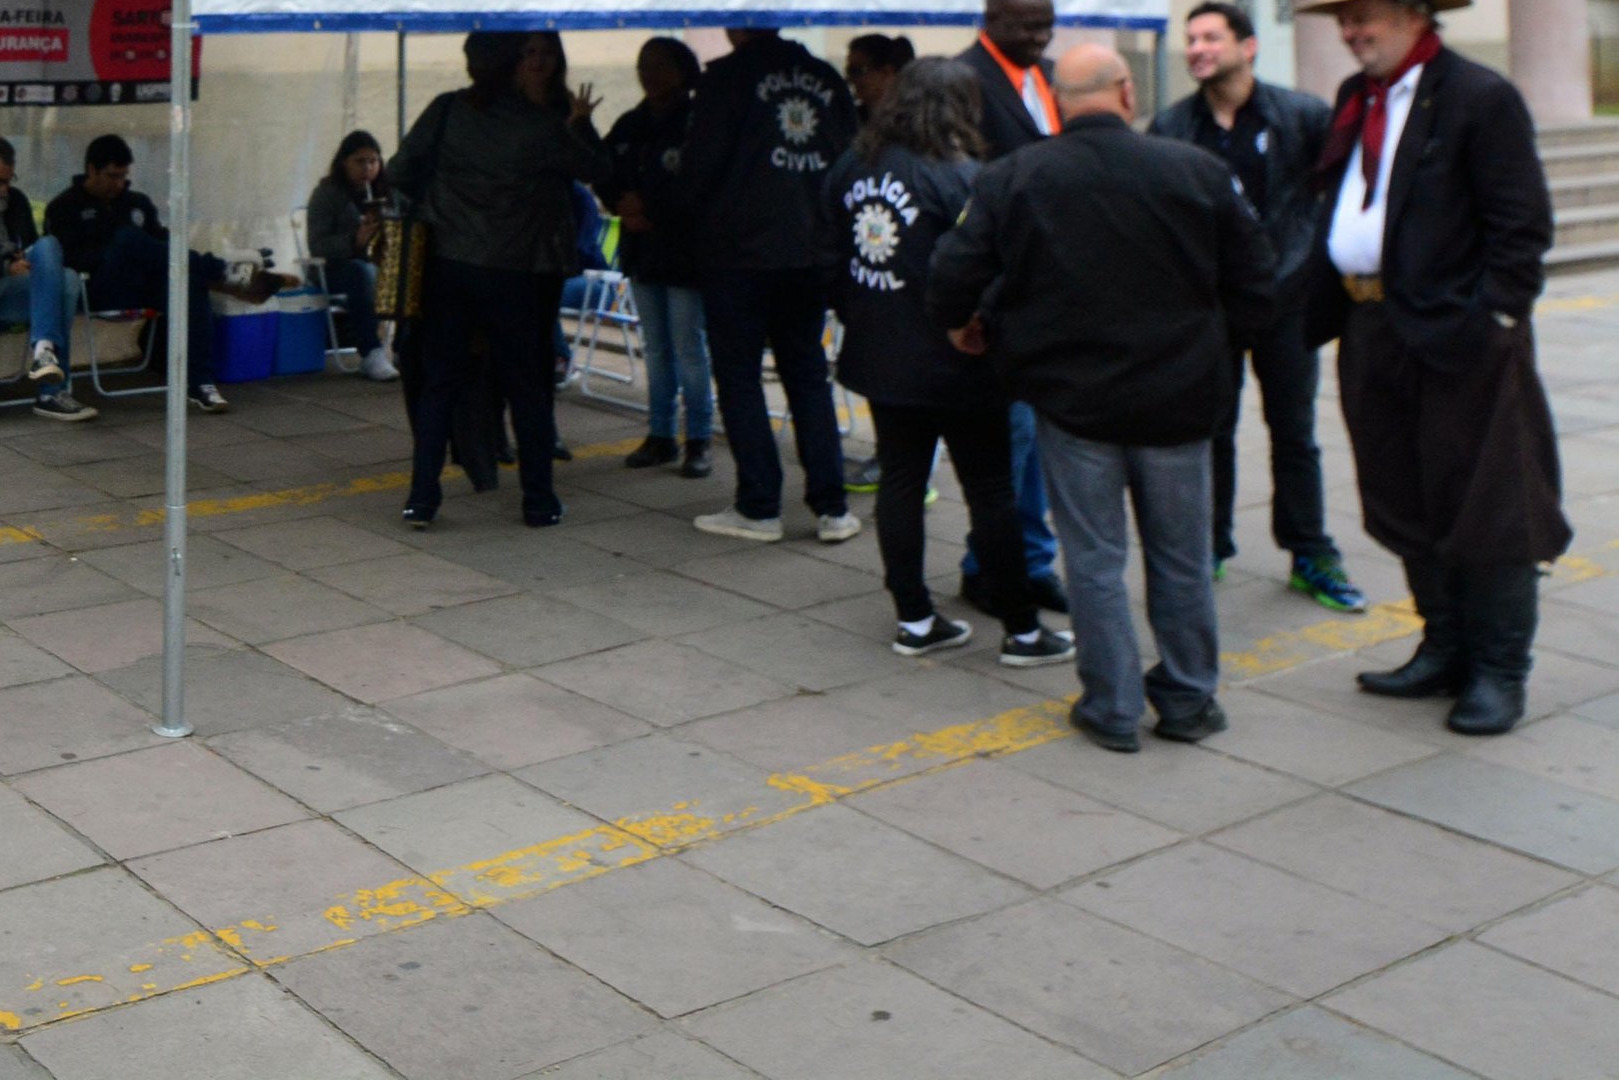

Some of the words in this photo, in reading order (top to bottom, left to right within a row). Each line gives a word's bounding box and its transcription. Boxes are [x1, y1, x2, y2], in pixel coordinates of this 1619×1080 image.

[756, 66, 834, 108] POLÍCIA
[771, 146, 828, 173] CIVIL
[843, 171, 920, 227] POLÍCIA
[850, 257, 906, 292] CIVIL
